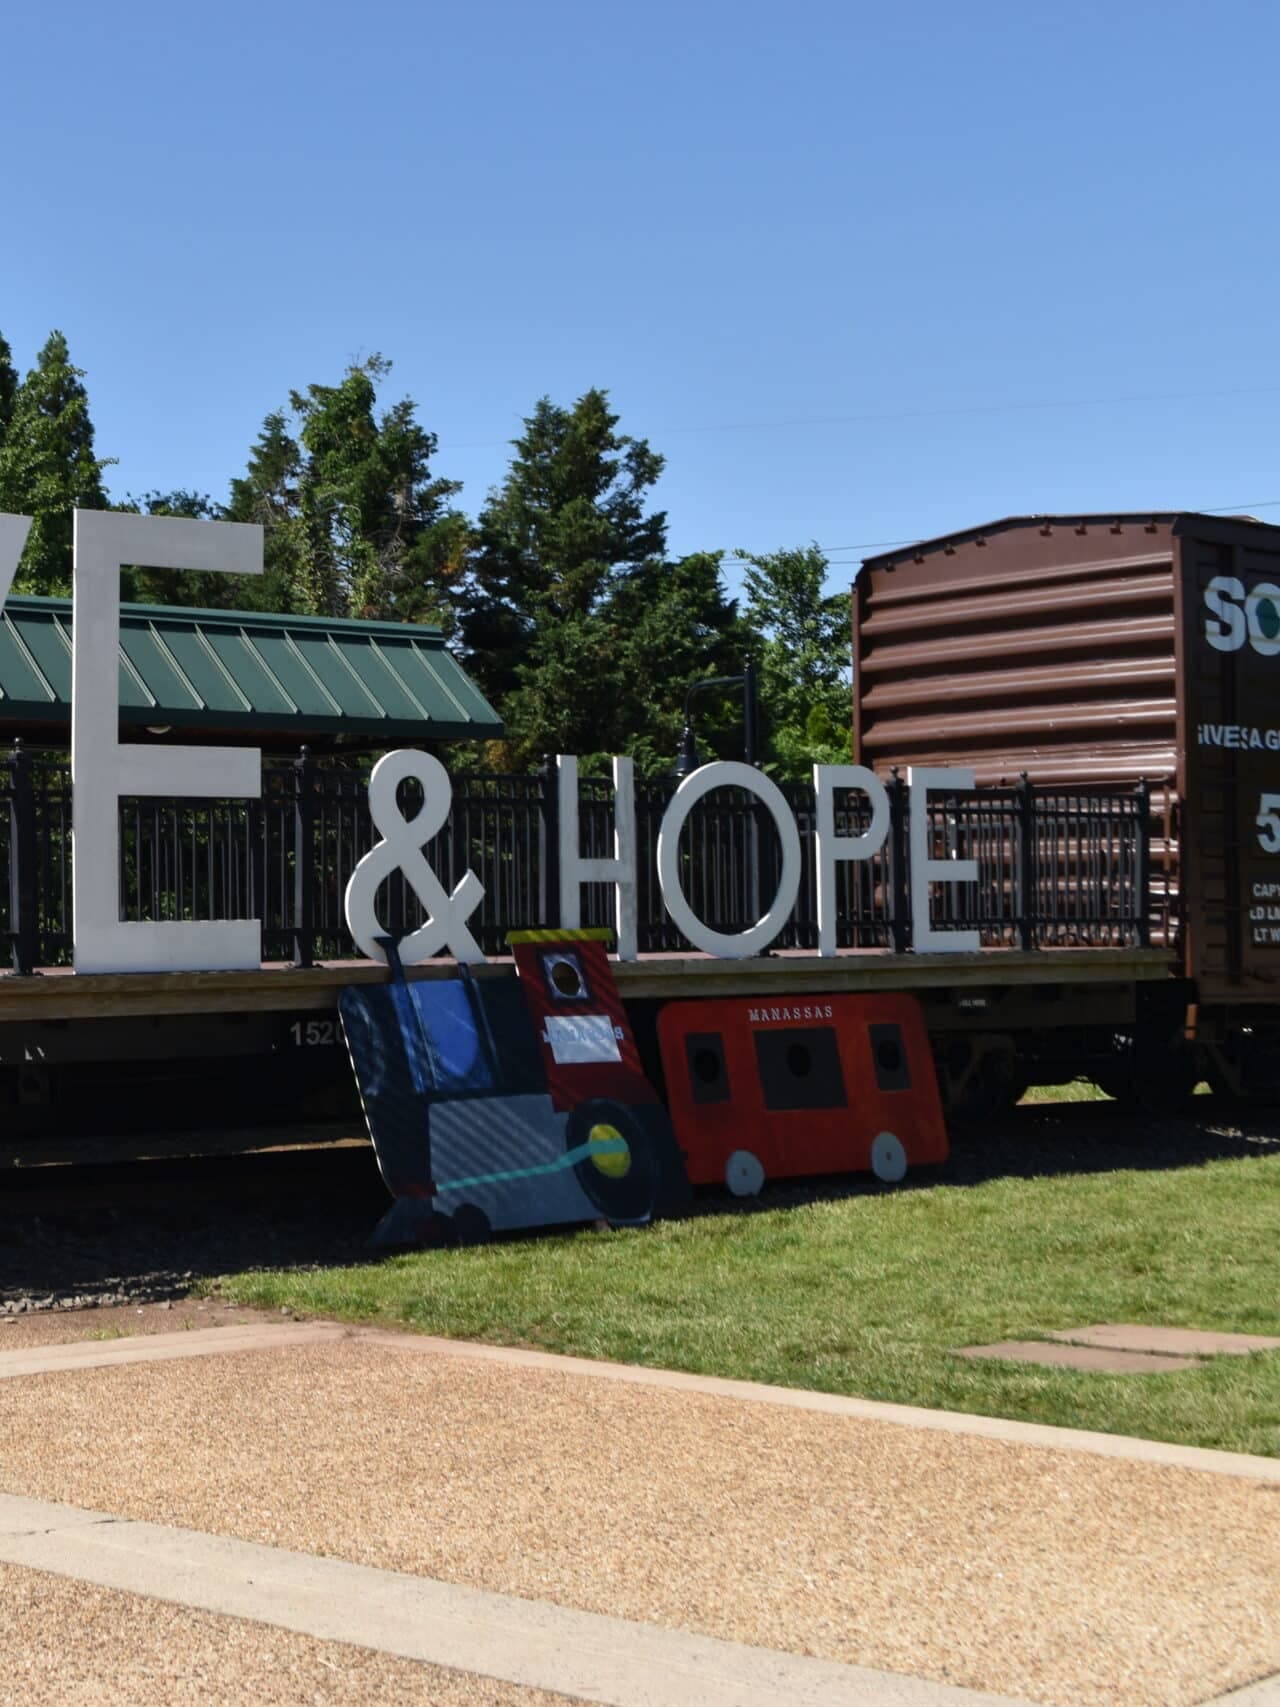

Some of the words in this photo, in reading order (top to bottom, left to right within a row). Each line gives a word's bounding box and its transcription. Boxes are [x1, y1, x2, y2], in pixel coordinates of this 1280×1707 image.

[344, 748, 487, 965] &
[556, 754, 981, 961] HOPE
[748, 1006, 832, 1022] MANASSAS
